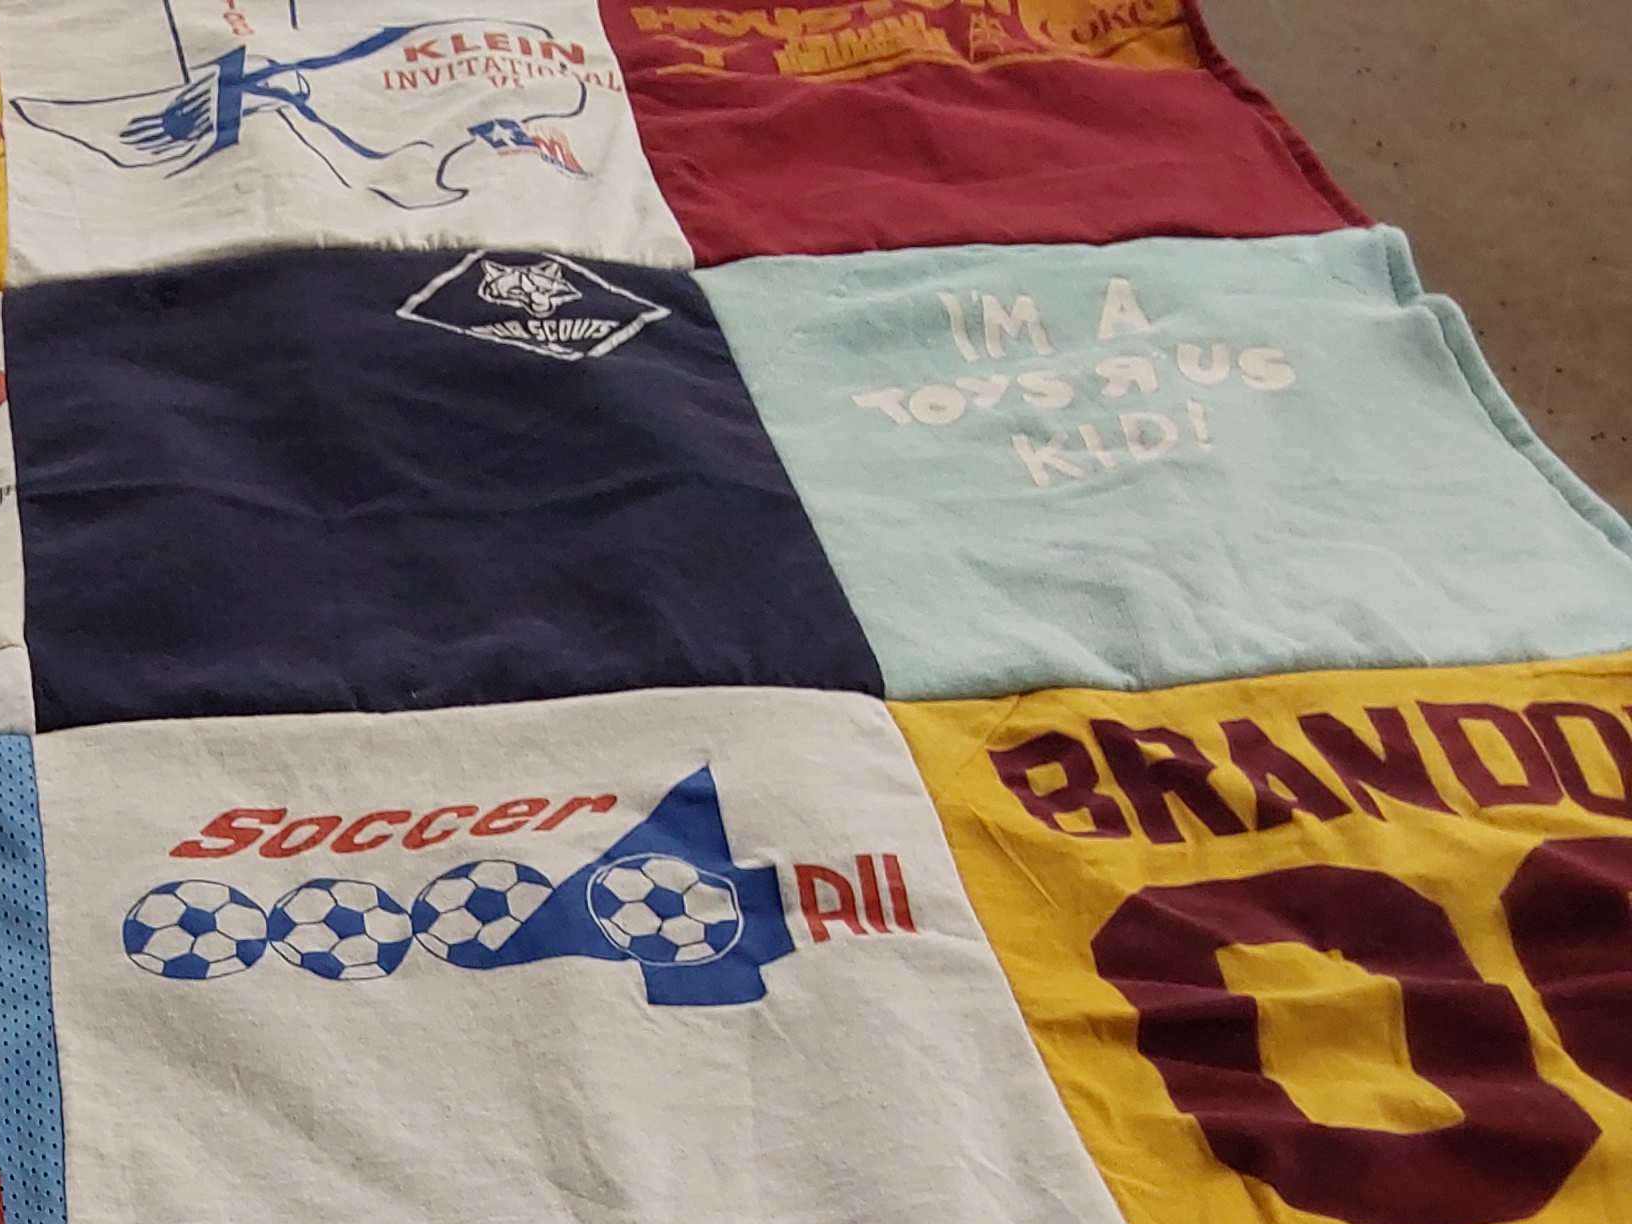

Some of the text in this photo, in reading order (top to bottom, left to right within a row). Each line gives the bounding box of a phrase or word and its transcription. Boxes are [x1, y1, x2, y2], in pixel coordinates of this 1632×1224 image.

[404, 33, 585, 65] KLEIN
[527, 318, 620, 342] SCOUTS
[938, 277, 1151, 363] I'M A
[852, 369, 1075, 426] TOYS
[1176, 343, 1296, 391] US
[1011, 398, 1212, 488] KID!
[986, 700, 1632, 845] BRANDO
[168, 793, 618, 858] Soccer
